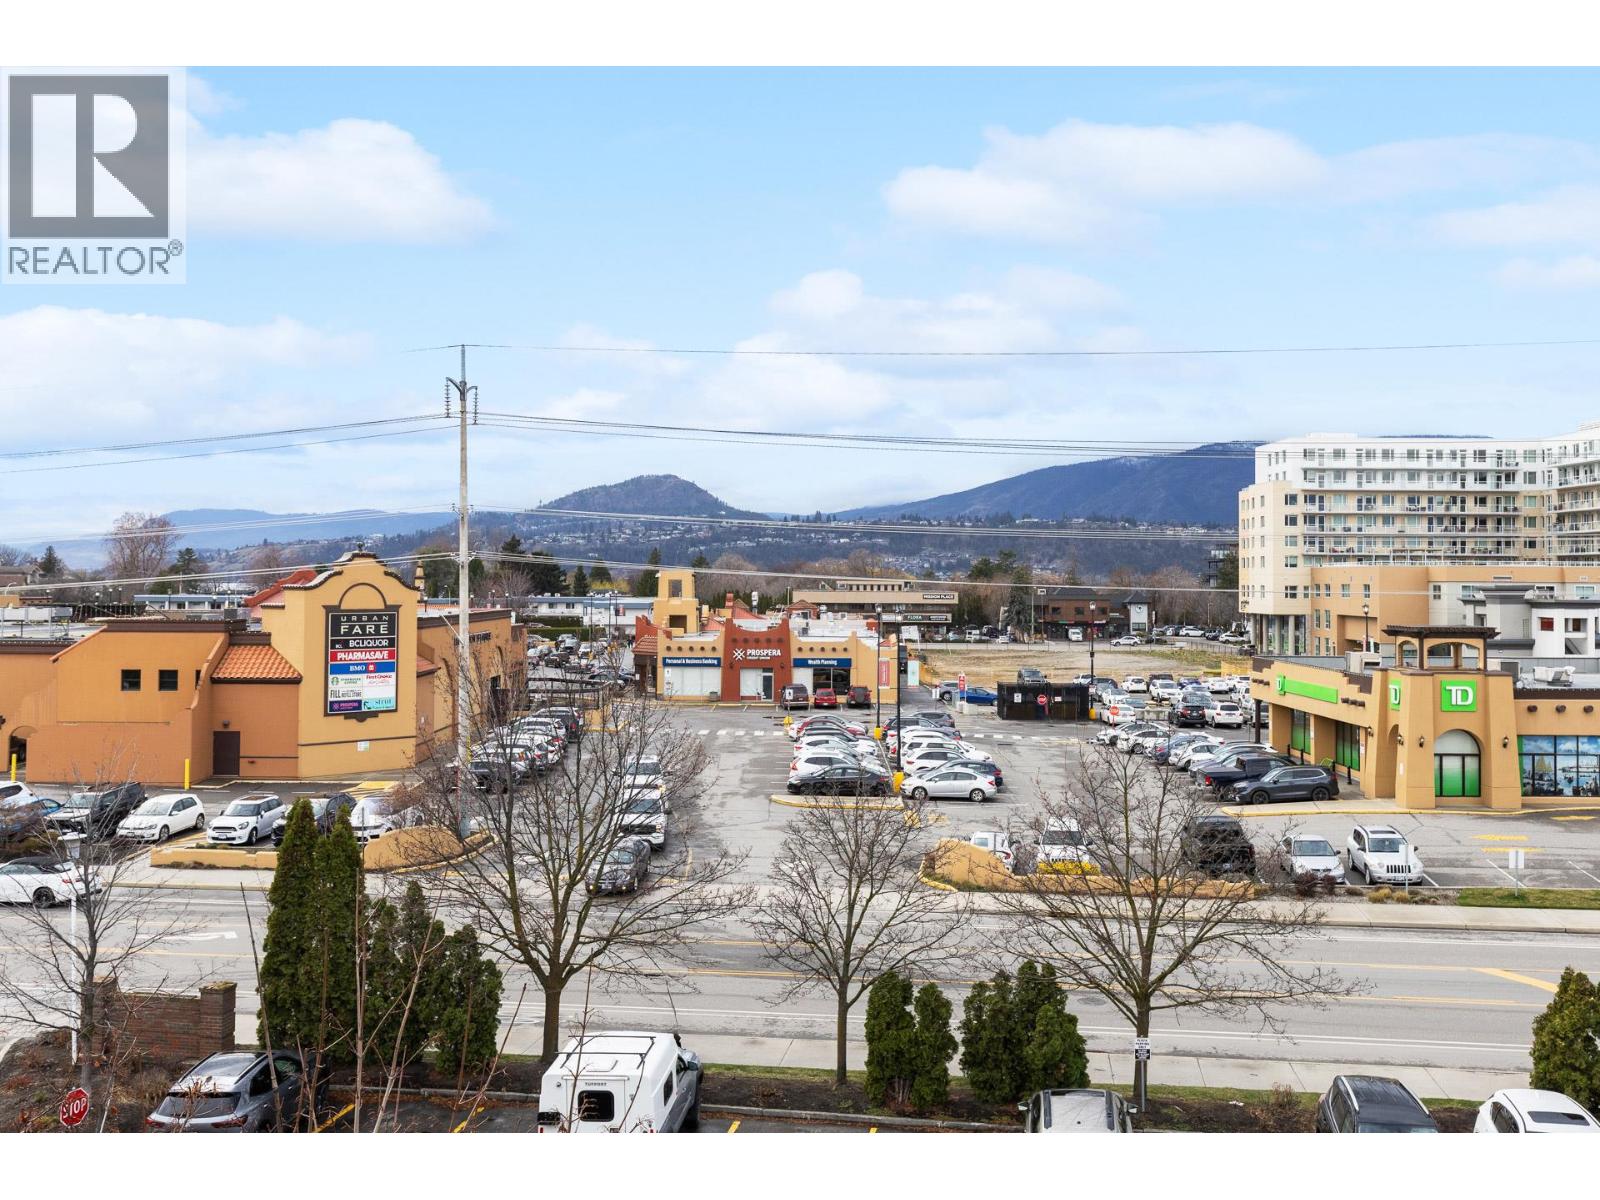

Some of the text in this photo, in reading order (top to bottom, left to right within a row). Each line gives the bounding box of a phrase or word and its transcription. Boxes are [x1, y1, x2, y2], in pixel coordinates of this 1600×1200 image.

[341, 625, 388, 635] FARE
[337, 651, 389, 660] PHARMASAVE
[330, 690, 341, 698] FILL
[1446, 686, 1474, 706] TD
[63, 1098, 86, 1118] STOP
